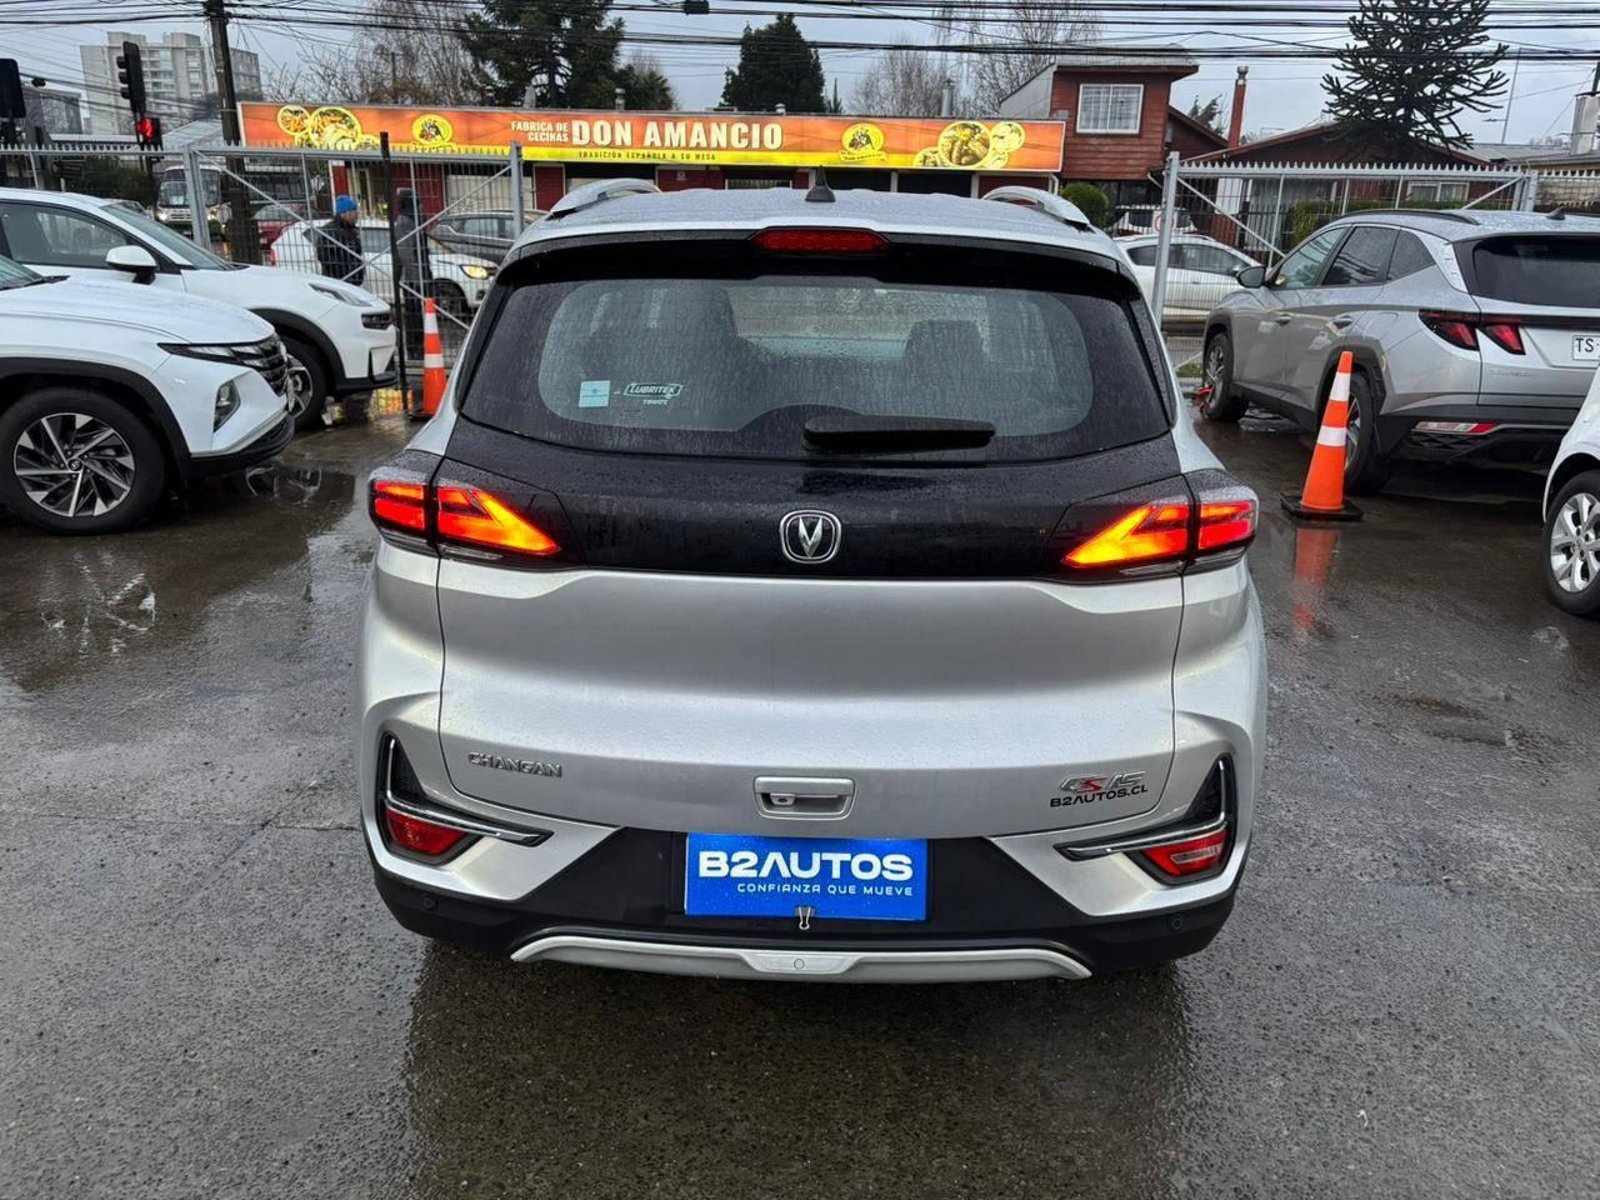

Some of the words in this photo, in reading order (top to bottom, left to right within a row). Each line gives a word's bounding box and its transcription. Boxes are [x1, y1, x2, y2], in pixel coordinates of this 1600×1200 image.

[511, 120, 554, 132] FABRICA
[556, 121, 569, 132] DE
[528, 131, 569, 142] CECINAS
[572, 119, 633, 147] DON
[643, 121, 783, 150] AMANCIO
[468, 751, 562, 778] CHANGAN
[1050, 784, 1148, 808] B2AUTOS.CL
[699, 850, 914, 882] B2AUTOS
[737, 883, 821, 894] CONFIANZA
[827, 885, 857, 895] QUE
[863, 886, 913, 897] MUEVE
